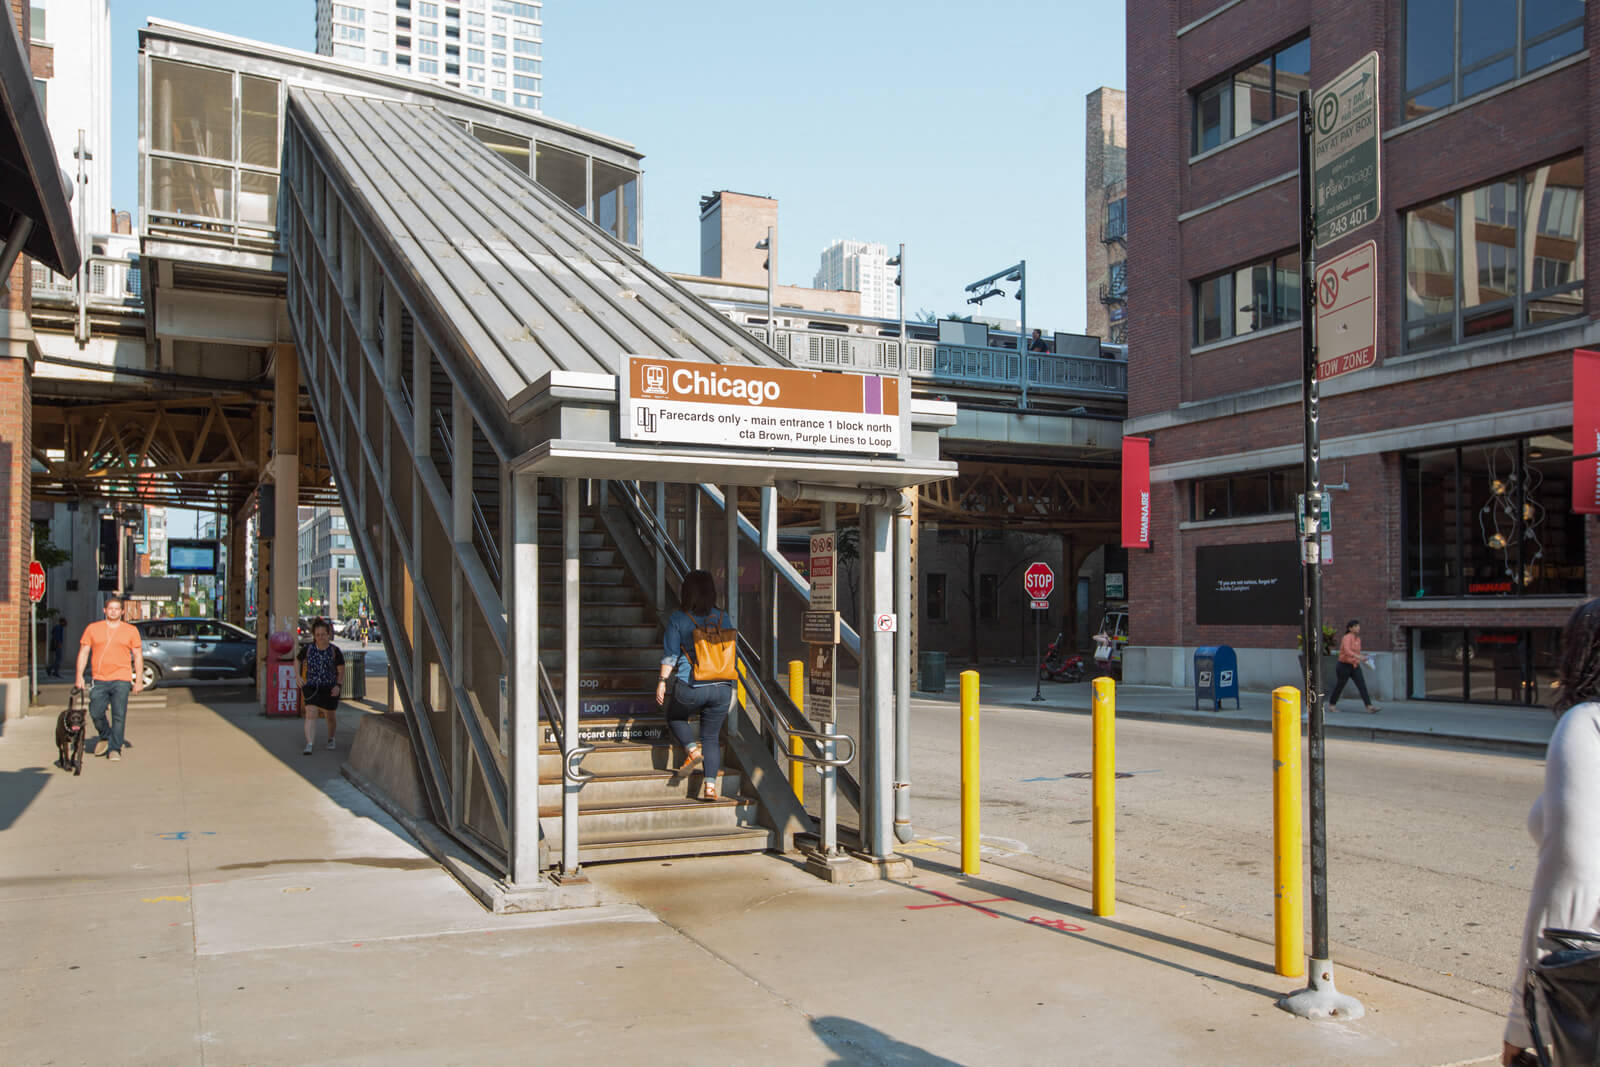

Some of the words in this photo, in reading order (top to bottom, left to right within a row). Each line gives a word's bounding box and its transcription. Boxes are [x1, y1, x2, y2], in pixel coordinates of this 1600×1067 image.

[1316, 143, 1328, 158] PAY
[1330, 135, 1338, 149] AT
[1340, 126, 1353, 143] PAY
[1356, 116, 1372, 133] BOX
[1330, 216, 1347, 237] 243
[1350, 205, 1368, 226] 401
[1319, 360, 1338, 377] TOW
[1343, 348, 1369, 370] ZONE
[672, 368, 780, 405] Chicago
[660, 409, 715, 422] Farecards
[718, 414, 741, 426] only
[751, 416, 777, 426] main
[780, 418, 825, 429] entrance
[828, 420, 833, 429] 1
[837, 420, 864, 431] block
[866, 423, 892, 433] north
[739, 430, 756, 439] cta
[759, 430, 793, 443] Brown,
[796, 433, 827, 445] Purple
[830, 434, 855, 445] Lines
[857, 437, 867, 445] to
[869, 437, 892, 449] Loop
[1140, 492, 1149, 542] LUMINAIRE
[1027, 574, 1052, 588] STOP
[580, 679, 599, 689] oop
[278, 702, 297, 712] EYE
[584, 703, 610, 714] Loop
[579, 730, 605, 740] recard
[607, 730, 641, 739] entrance
[644, 728, 661, 738] only
